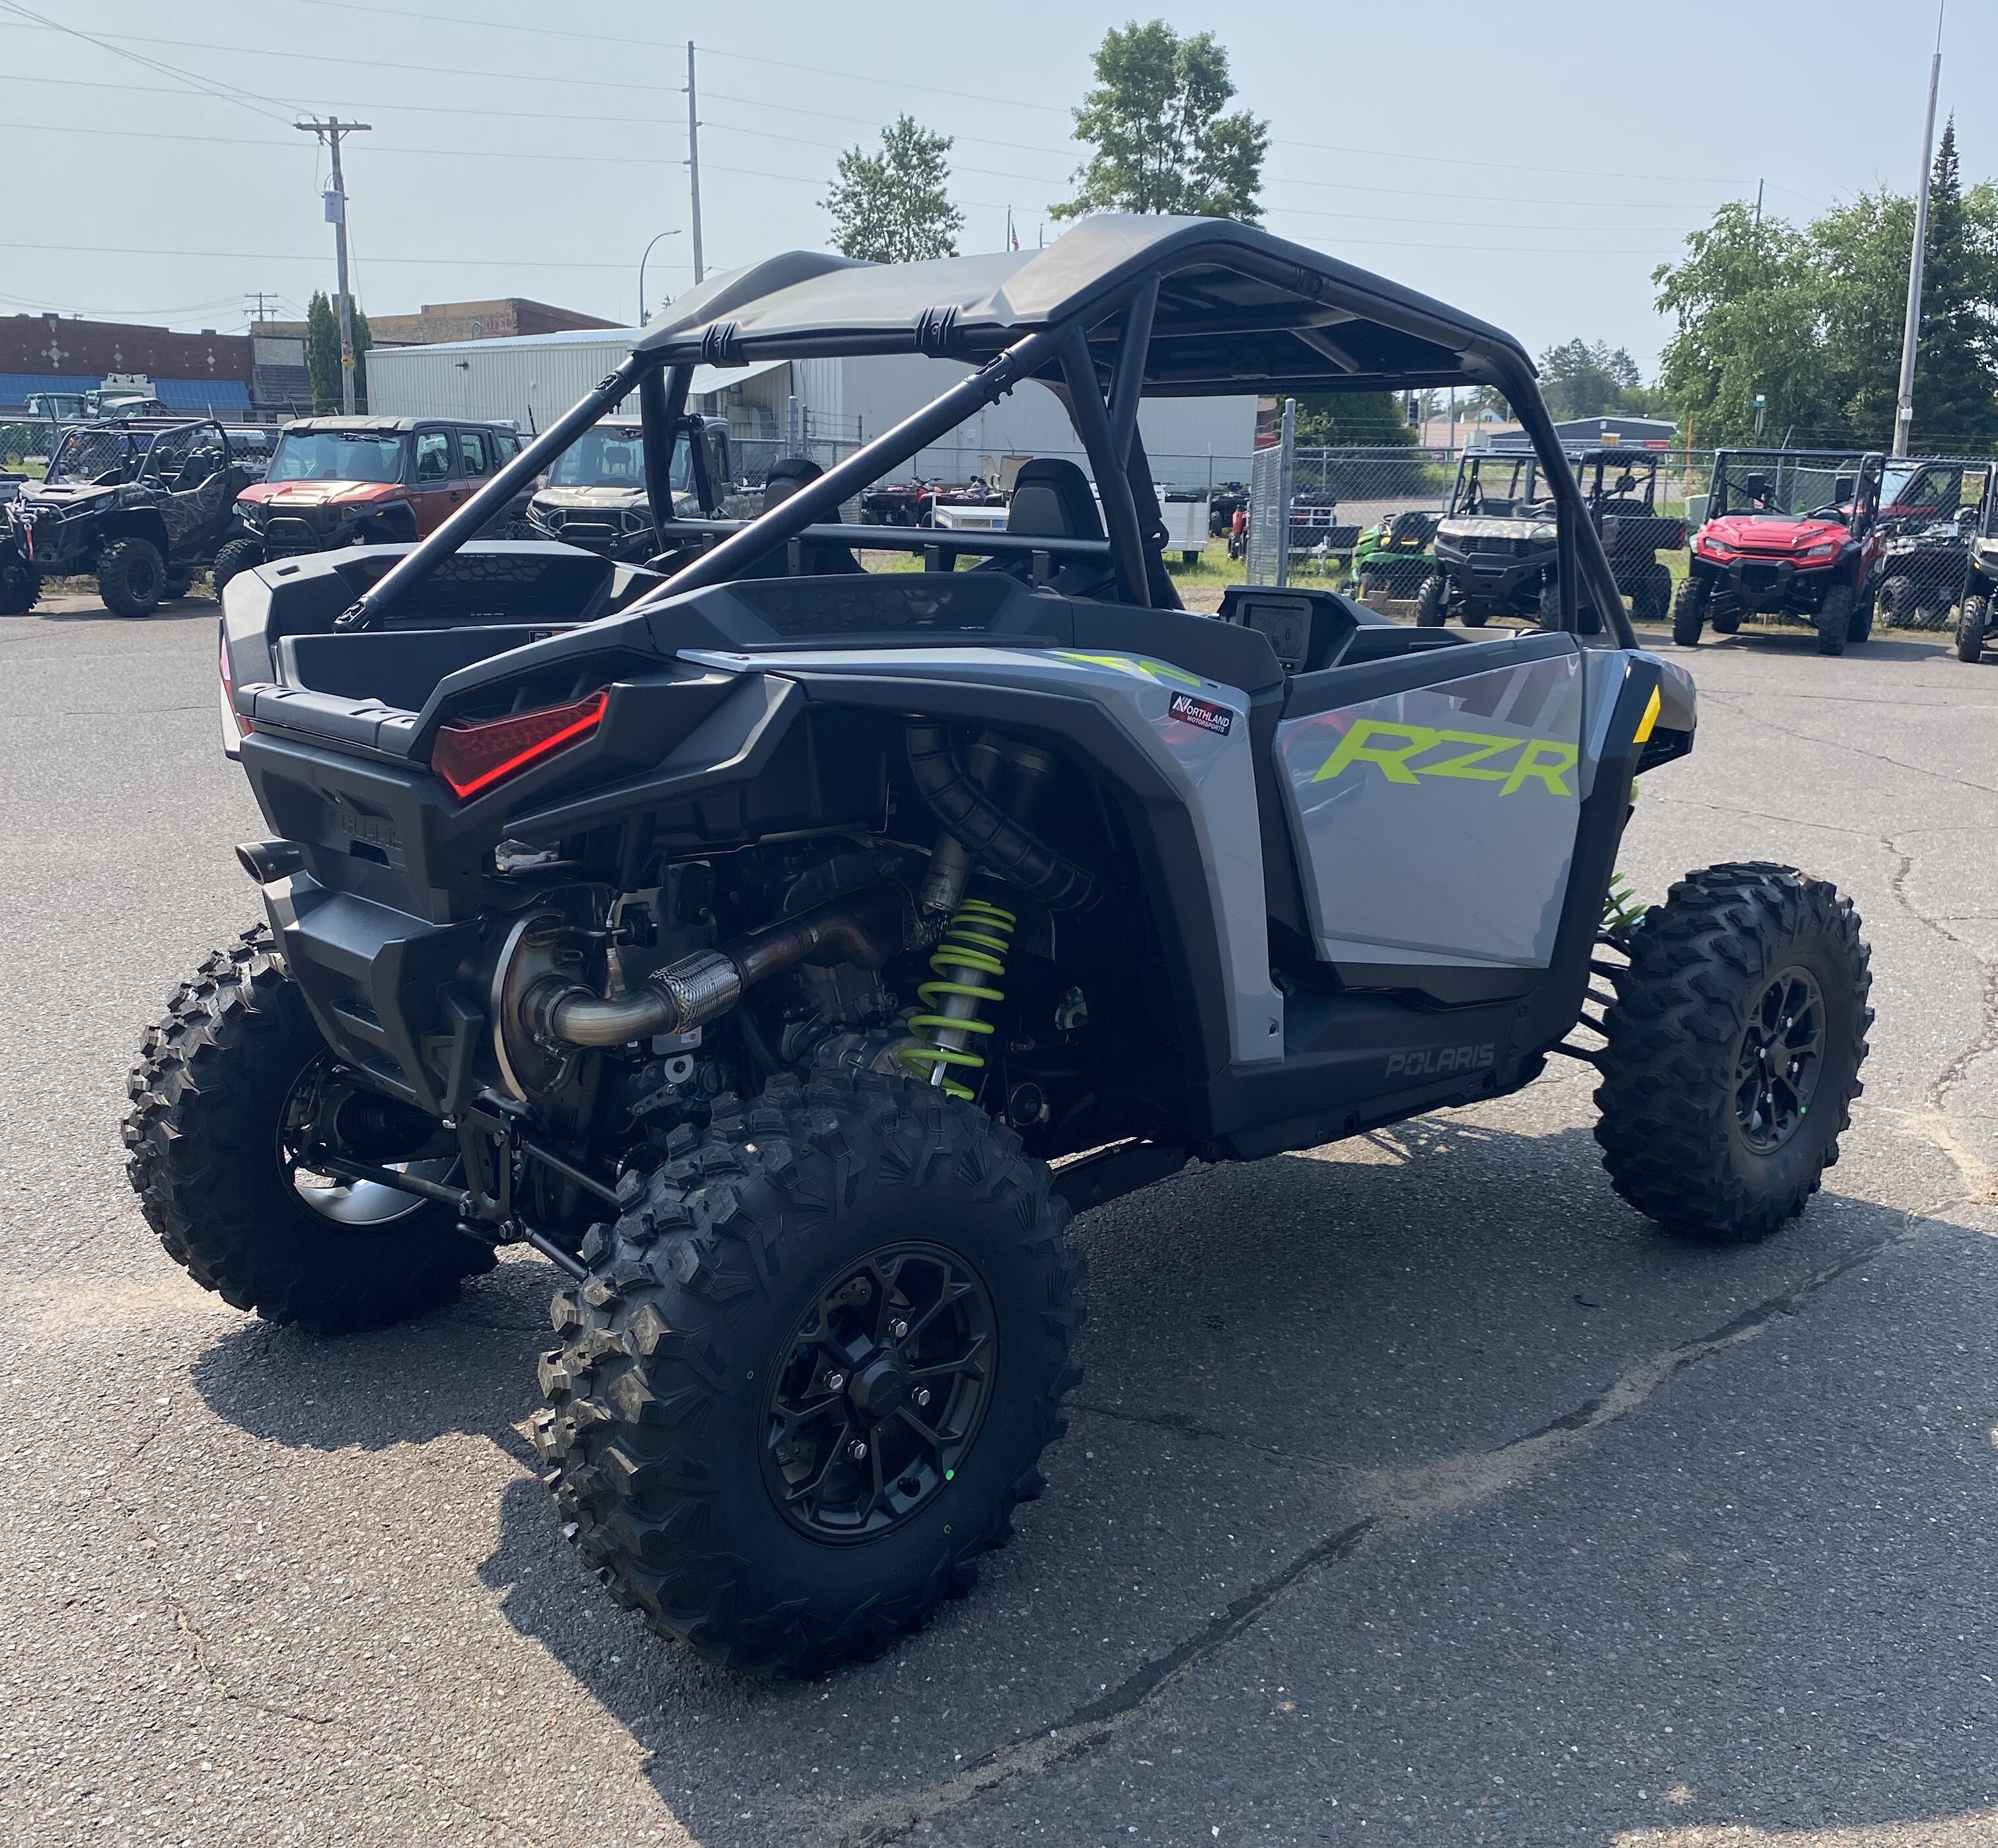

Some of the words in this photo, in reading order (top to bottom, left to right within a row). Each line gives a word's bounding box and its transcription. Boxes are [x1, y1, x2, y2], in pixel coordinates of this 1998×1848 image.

[1172, 695, 1230, 727] NORTHLAND
[1187, 715, 1225, 733] MOTORSPORTS
[1310, 719, 1578, 797] RZR
[1385, 1043, 1495, 1078] POLARIS
